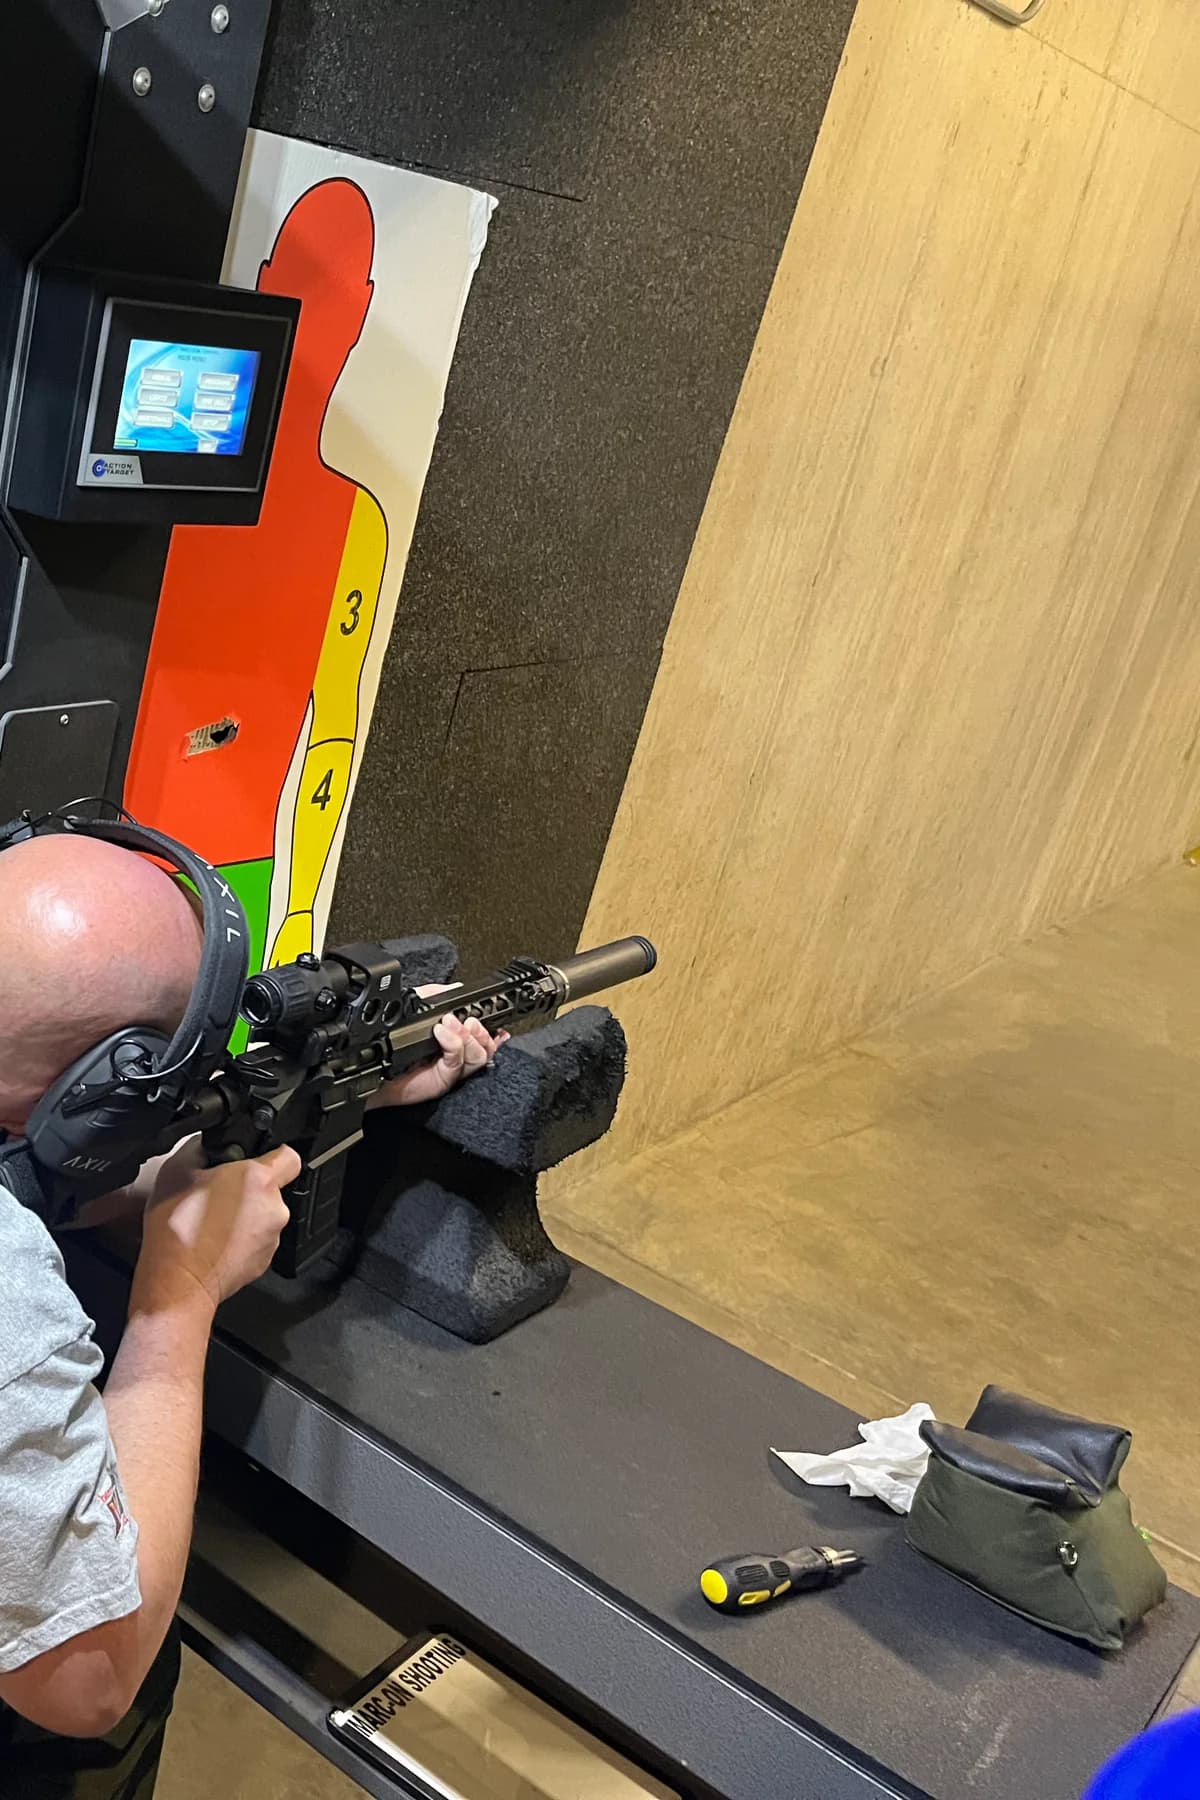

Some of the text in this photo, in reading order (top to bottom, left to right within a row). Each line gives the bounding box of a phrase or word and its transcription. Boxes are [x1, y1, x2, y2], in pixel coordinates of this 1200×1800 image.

[339, 589, 363, 636] 3
[311, 768, 334, 811] 4
[347, 1638, 466, 1738] MARC-ON SHOOTING
